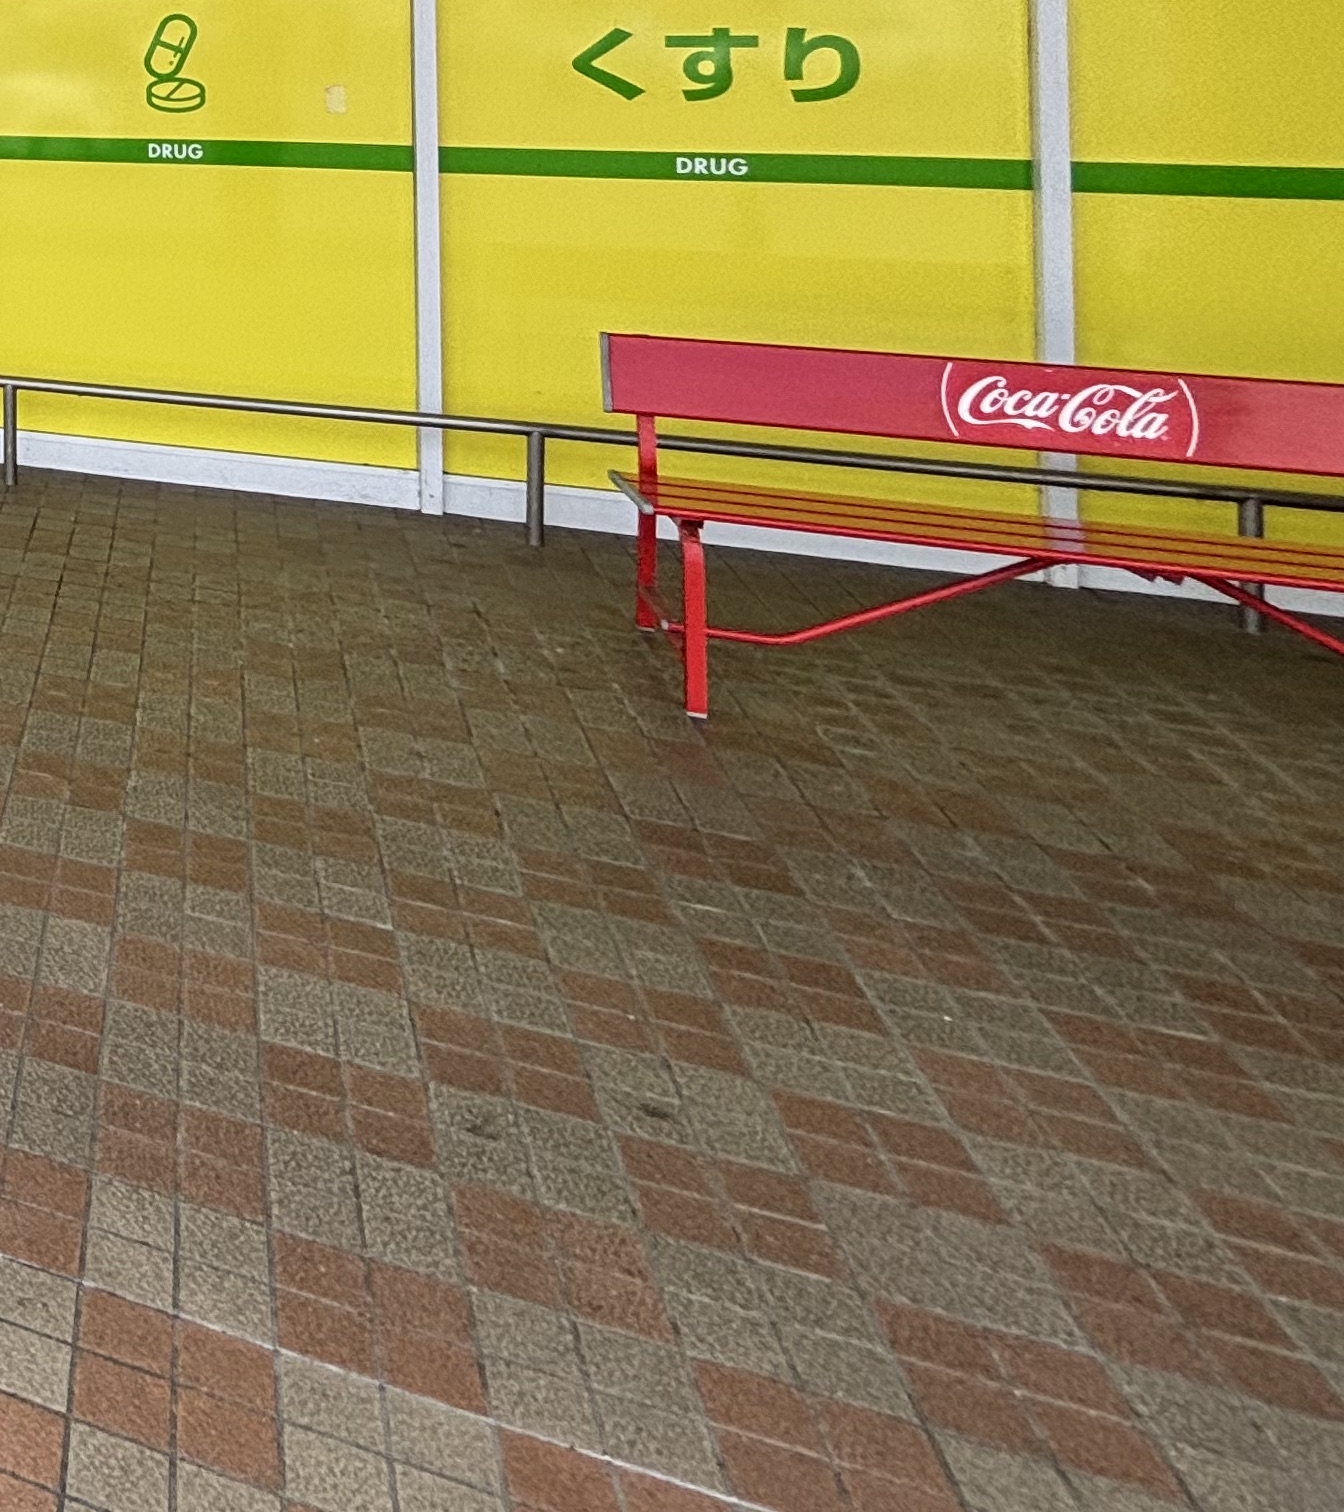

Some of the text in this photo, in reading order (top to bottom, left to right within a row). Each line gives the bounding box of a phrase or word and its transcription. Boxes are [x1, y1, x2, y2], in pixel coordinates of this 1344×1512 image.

[572, 27, 861, 102] くすり
[147, 143, 204, 161] DRUG
[675, 157, 749, 176] DRUG
[957, 375, 1179, 439] Coca-Cola
